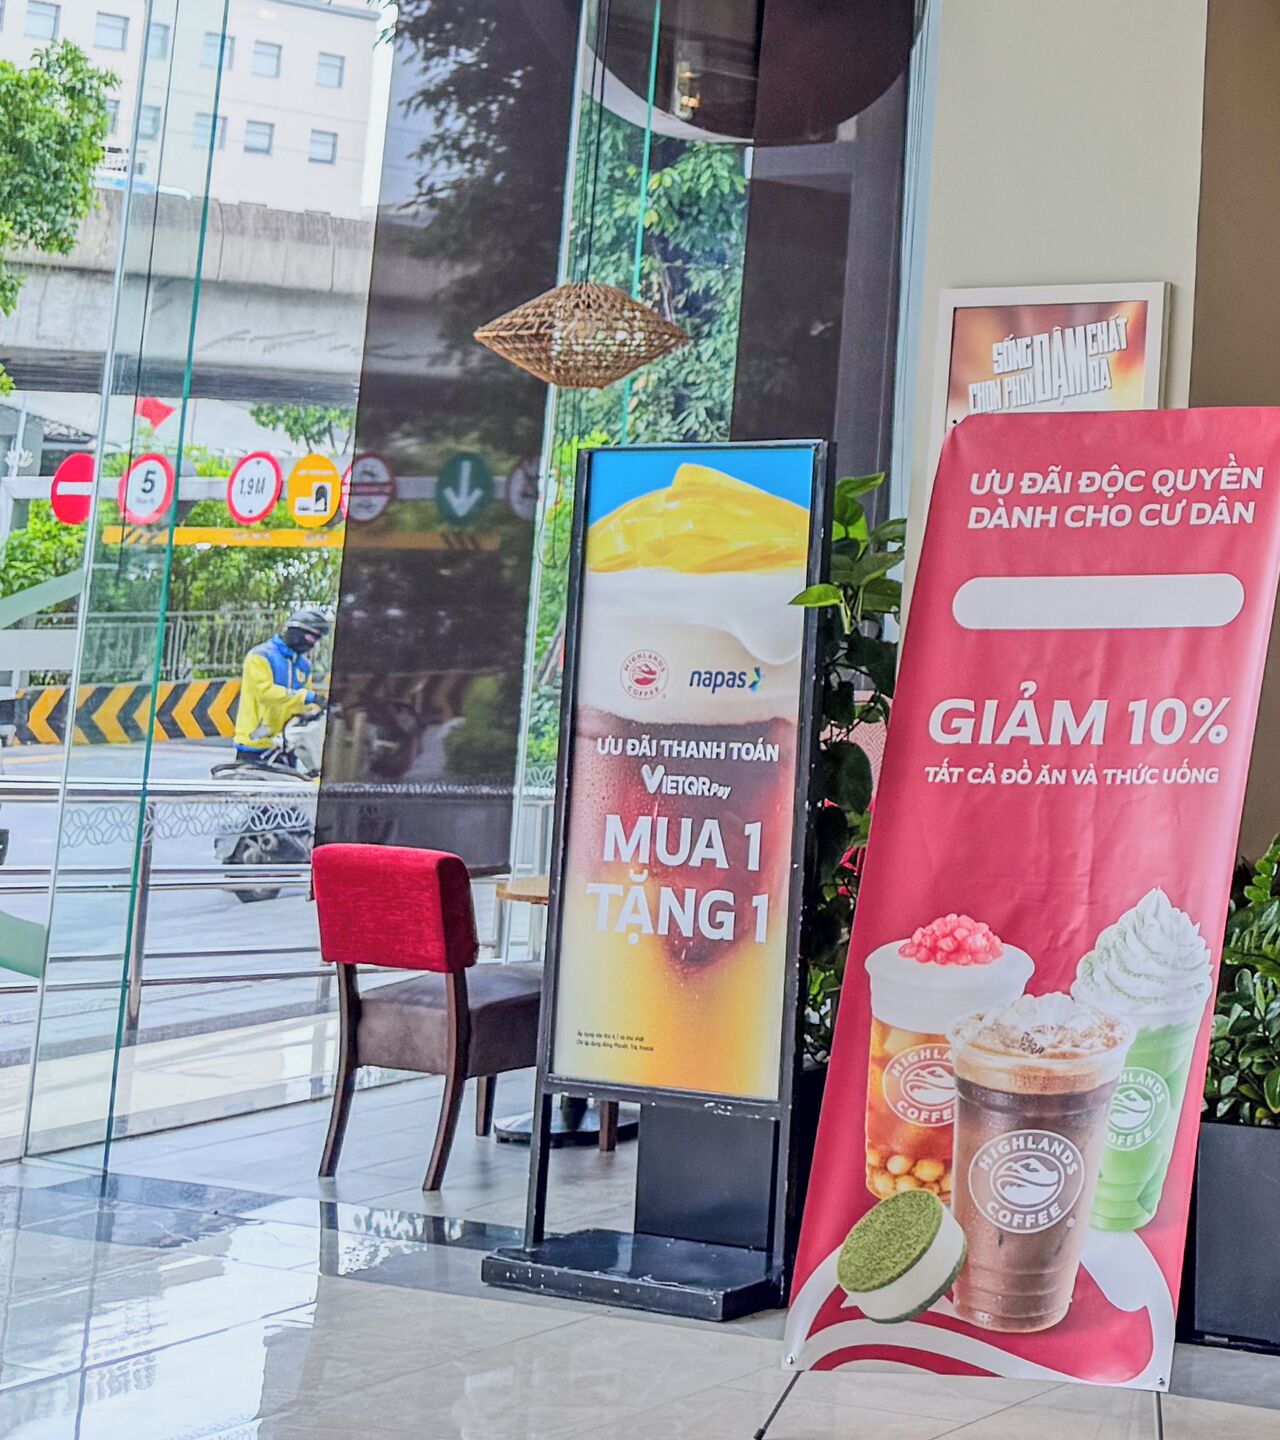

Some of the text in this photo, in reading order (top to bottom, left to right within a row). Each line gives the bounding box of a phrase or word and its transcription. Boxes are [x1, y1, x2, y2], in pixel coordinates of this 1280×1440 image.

[992, 334, 1033, 374] SỐNG
[1086, 313, 1128, 356] CHẤT
[1004, 373, 1036, 409] PHIN
[141, 469, 156, 494] 5
[969, 453, 1265, 501] ƯU ĐÃI ĐỘC QUYỀN
[967, 495, 1256, 530] DÀNH CHO CƯ DÂN
[688, 666, 748, 695] napas
[927, 680, 1233, 746] GIẢM 10%
[596, 734, 780, 762] ƯU ĐÃI THANH TOÁN
[925, 758, 1220, 785] TẤT CẢ ĐỒ ĂN VÀ THỨC UỐNG
[602, 813, 762, 871] MUA 1
[585, 868, 768, 945] TẶNG 1
[891, 1047, 953, 1078] HIGHLA
[1118, 1072, 1167, 1104] HLANDS
[896, 1100, 953, 1122] COFFE
[1107, 1126, 1153, 1146] OFFEE
[977, 1135, 1079, 1175] HIGHLANDS
[986, 1202, 1063, 1227] COFFEE
